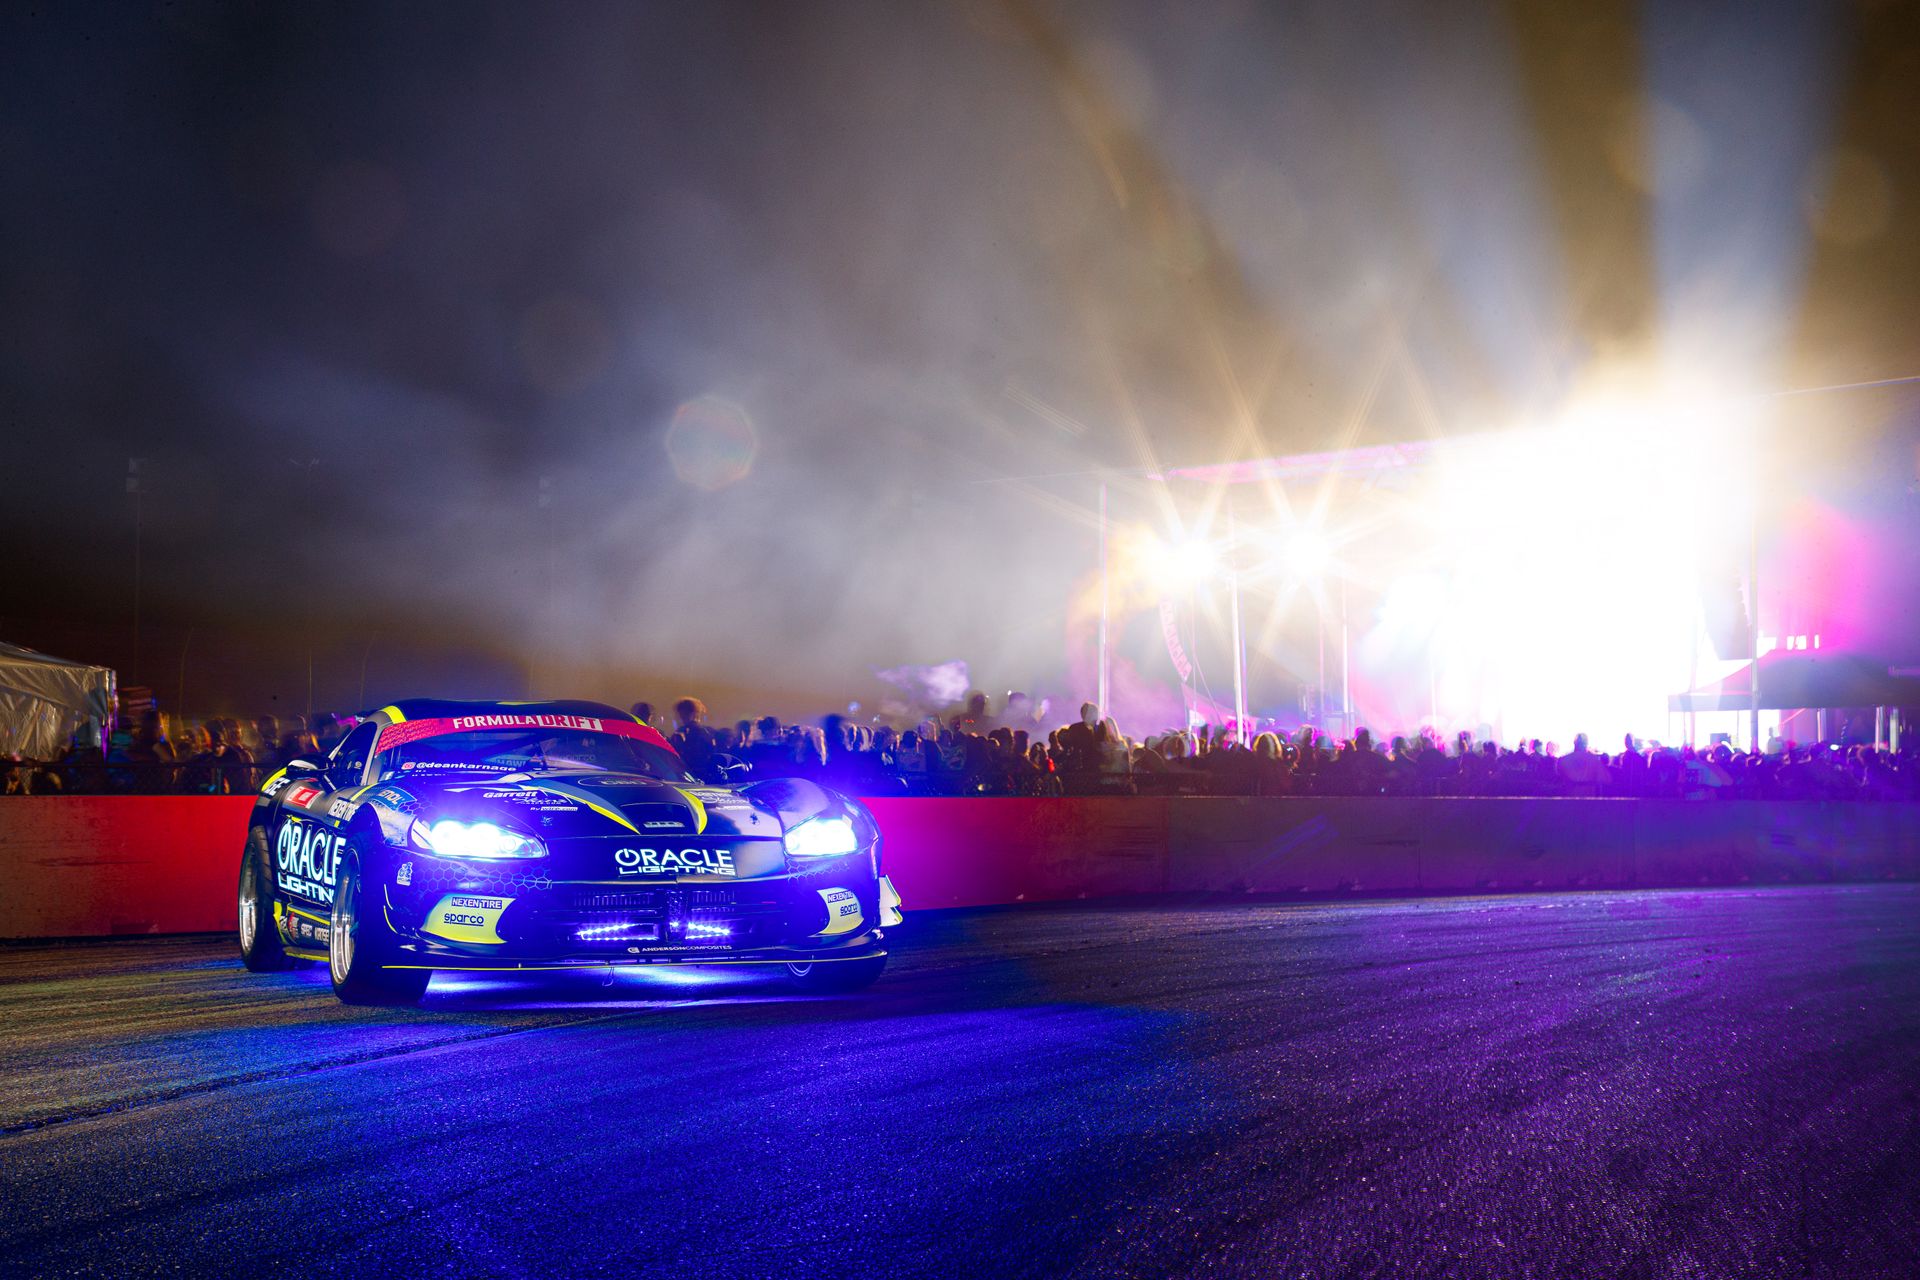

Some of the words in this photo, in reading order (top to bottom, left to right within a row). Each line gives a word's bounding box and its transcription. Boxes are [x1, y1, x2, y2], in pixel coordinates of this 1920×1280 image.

[453, 715, 536, 728] FORMULA
[539, 715, 601, 731] DRIFT
[416, 762, 517, 772] @deankarnage
[483, 791, 538, 799] Garrett
[278, 819, 347, 886] ORACLE
[615, 848, 734, 868] ORACLE
[619, 865, 736, 875] LIGHTING
[278, 871, 335, 904] LIGHTIN
[452, 898, 479, 908] NEXEN
[480, 899, 502, 909] TIRE
[443, 913, 484, 926] sparco
